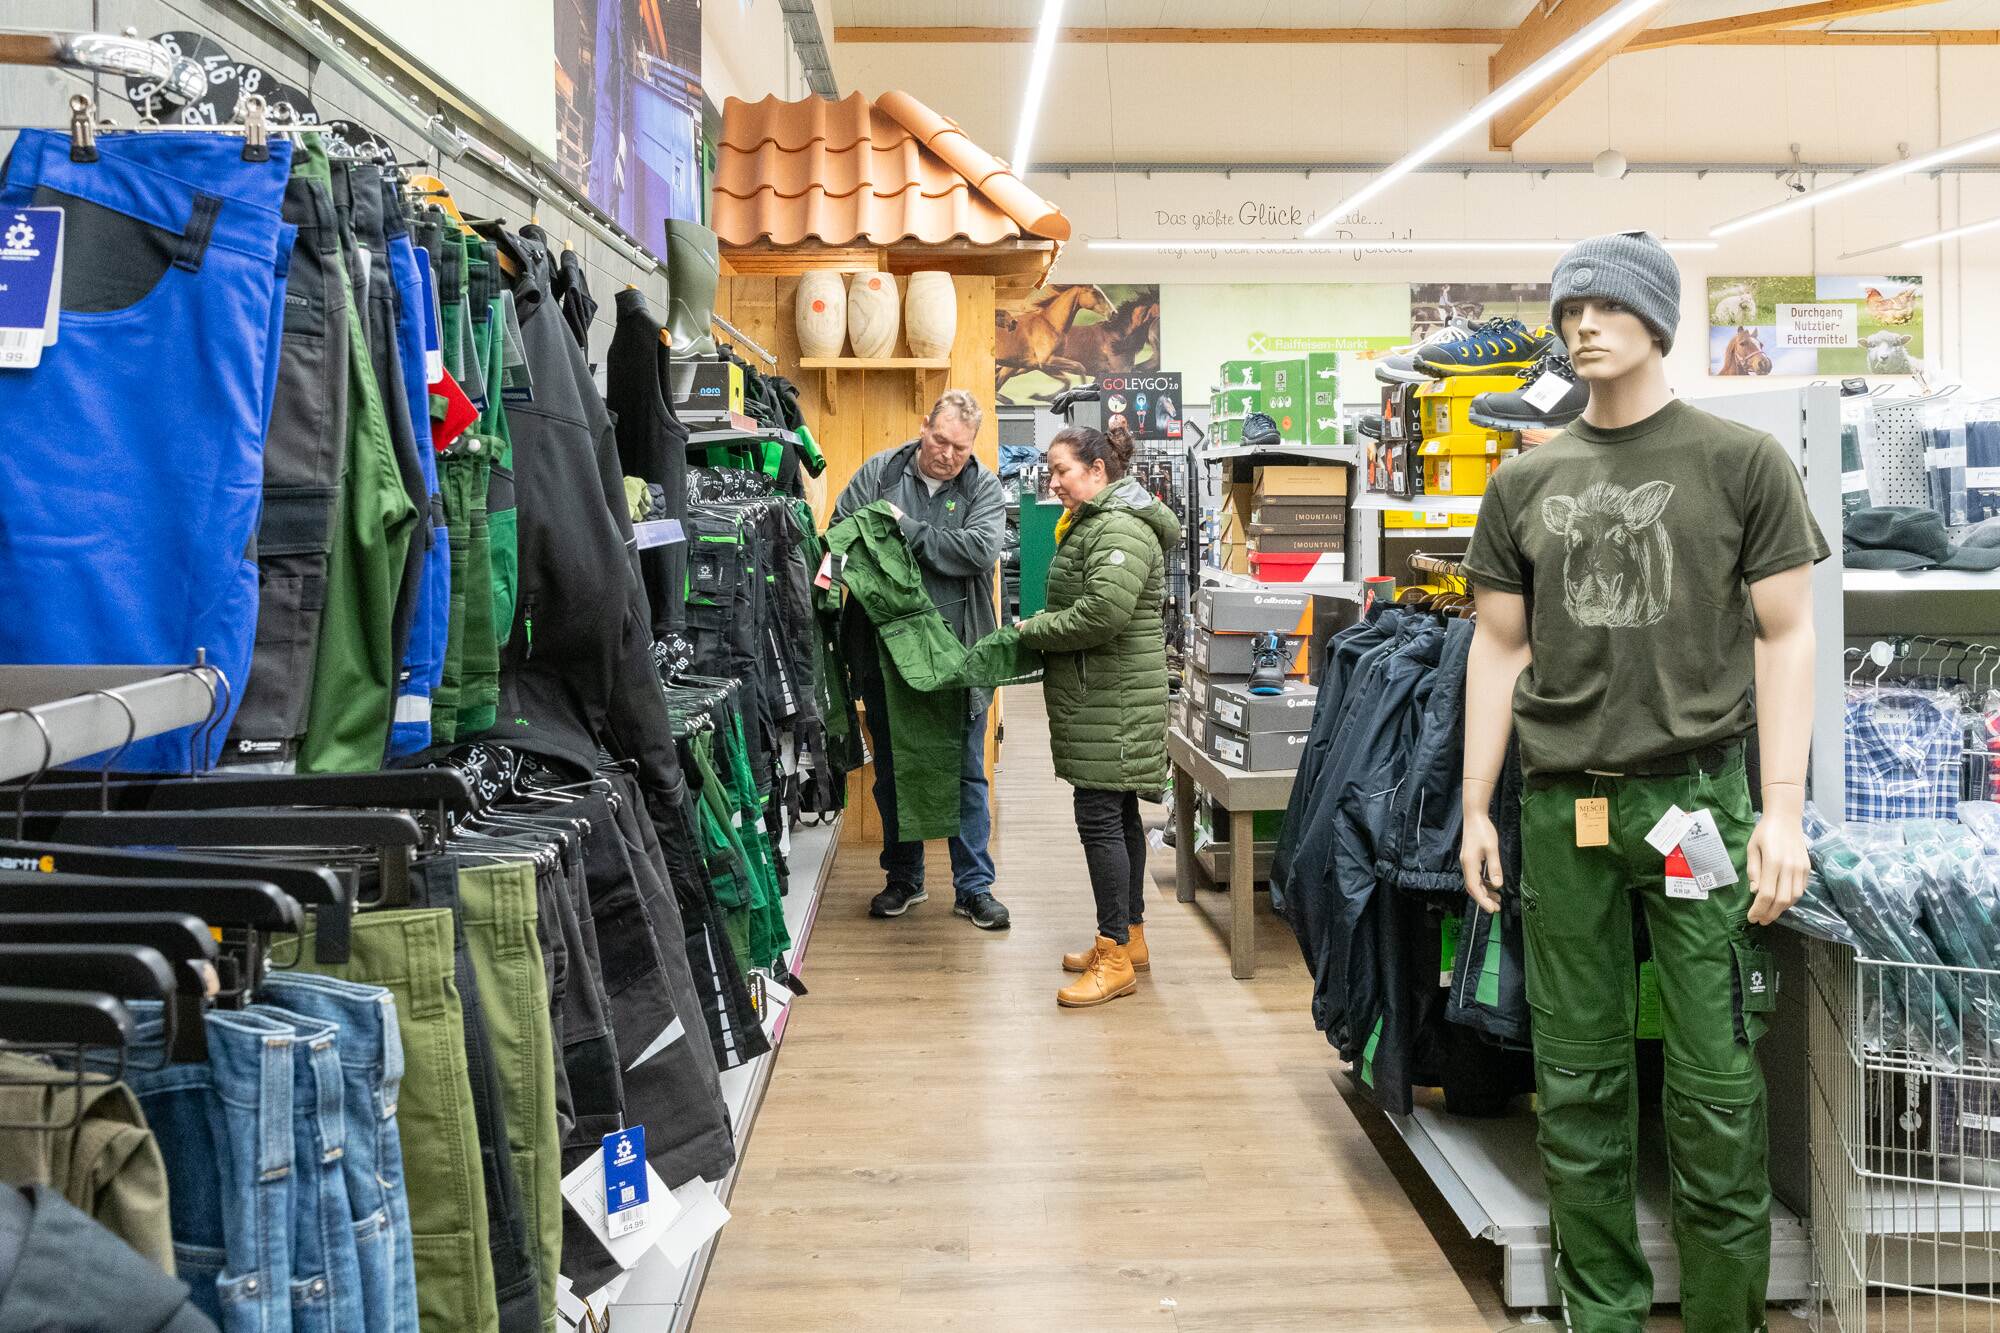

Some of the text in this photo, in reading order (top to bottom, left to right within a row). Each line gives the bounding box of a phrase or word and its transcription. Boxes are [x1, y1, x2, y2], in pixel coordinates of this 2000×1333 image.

[1153, 209, 1187, 226] Das
[1238, 200, 1302, 226] Glück
[1791, 307, 1843, 320] Durchgang
[1794, 321, 1840, 331] Nutztier-
[1275, 338, 1368, 350] Raiffeisen-Markt
[1787, 334, 1848, 345] Futtermittel
[1102, 377, 1169, 391] GOLEYGO
[673, 638, 687, 652] 60
[467, 748, 488, 770] 52
[479, 779, 498, 801] 52
